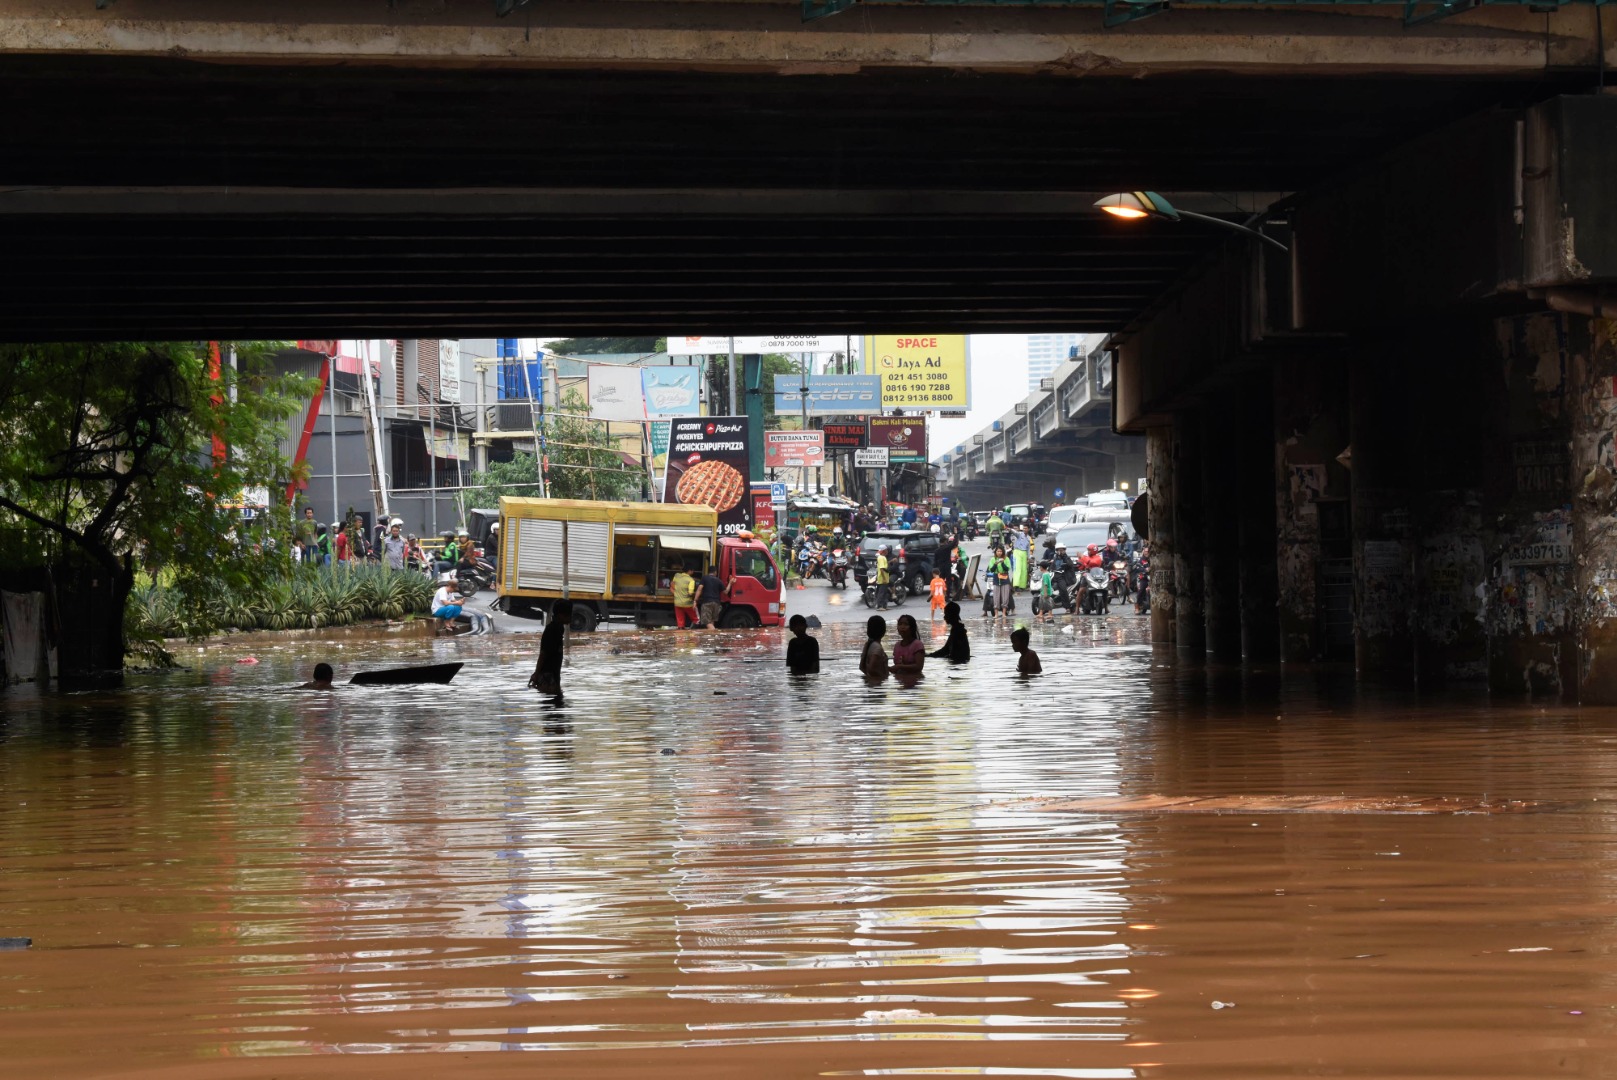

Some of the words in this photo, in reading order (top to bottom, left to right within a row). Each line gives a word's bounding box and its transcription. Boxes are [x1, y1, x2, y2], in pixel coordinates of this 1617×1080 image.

[896, 337, 938, 349] SPACE
[897, 357, 921, 371] Jaya
[925, 356, 942, 368] Ad
[926, 373, 948, 381] 3080
[823, 425, 847, 435] SINAR
[848, 425, 865, 435] MAS
[675, 442, 745, 451] #CHICKENPUFFPIZZA
